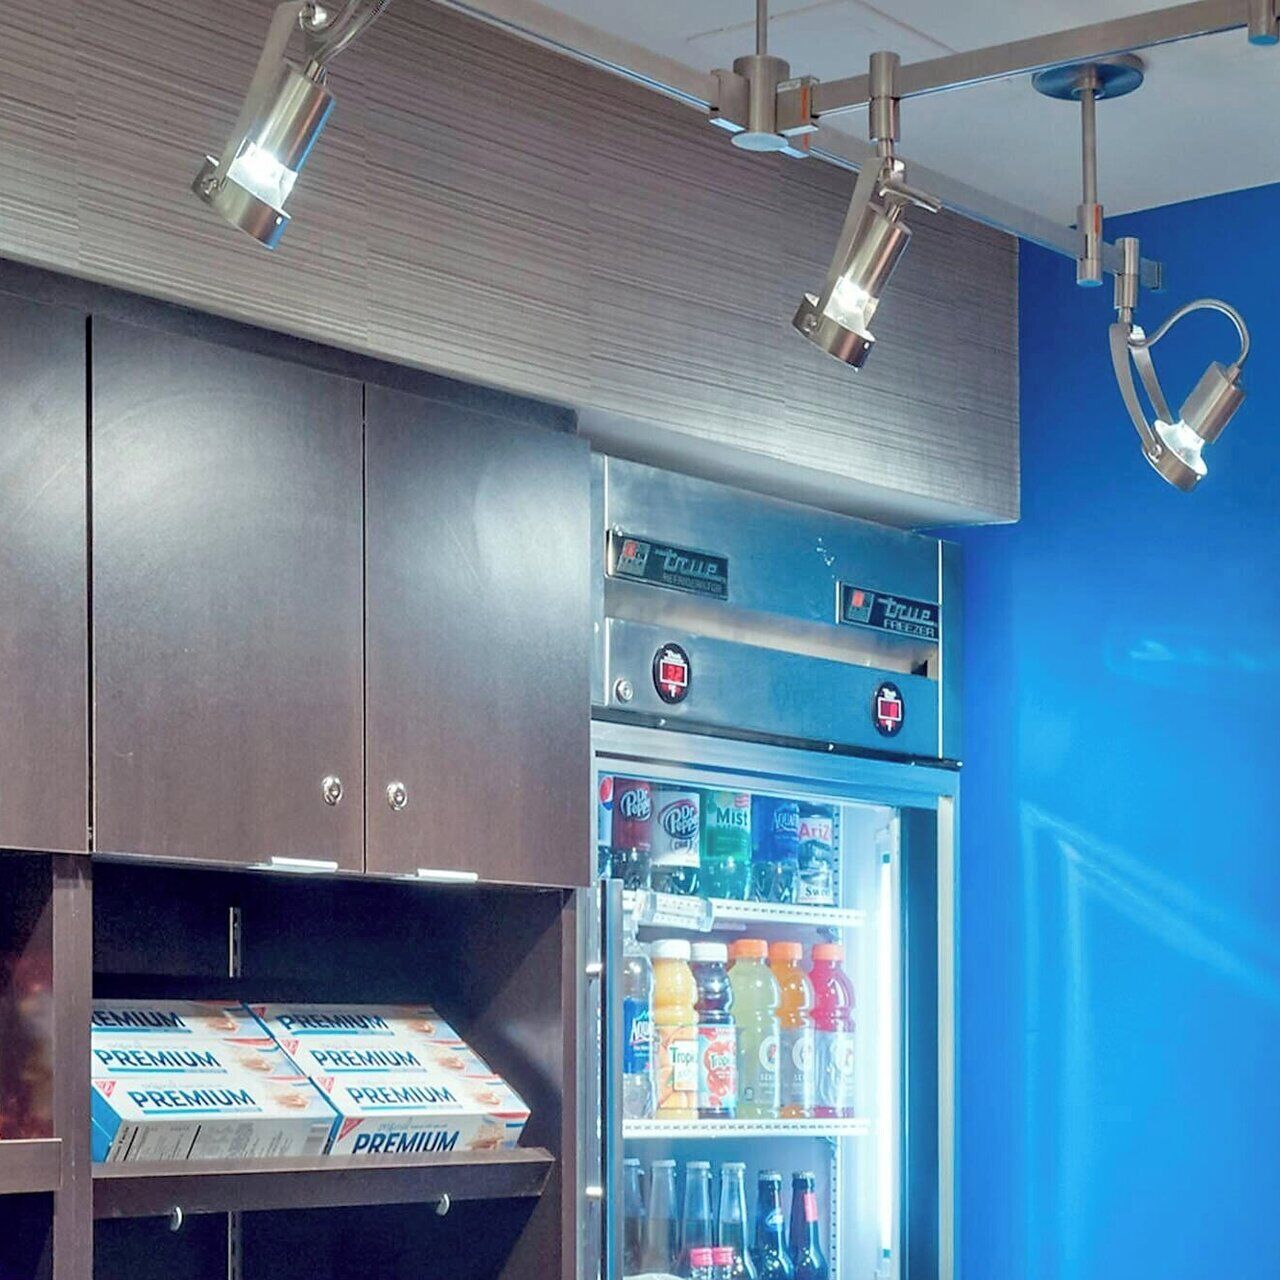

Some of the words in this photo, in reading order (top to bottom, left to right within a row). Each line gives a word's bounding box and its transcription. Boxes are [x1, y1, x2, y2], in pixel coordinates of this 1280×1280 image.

[884, 618, 934, 637] FREEZER
[716, 808, 748, 826] Mist
[799, 822, 830, 841] AriZ
[91, 1011, 186, 1028] REMIUM
[276, 1014, 390, 1031] PREMIUM
[93, 1049, 222, 1067] PREMIUM
[310, 1049, 422, 1067] PREMIUM
[127, 1089, 256, 1108] PREMIUM
[346, 1086, 458, 1104] PREMIUM
[352, 1131, 460, 1154] PREMIUM
